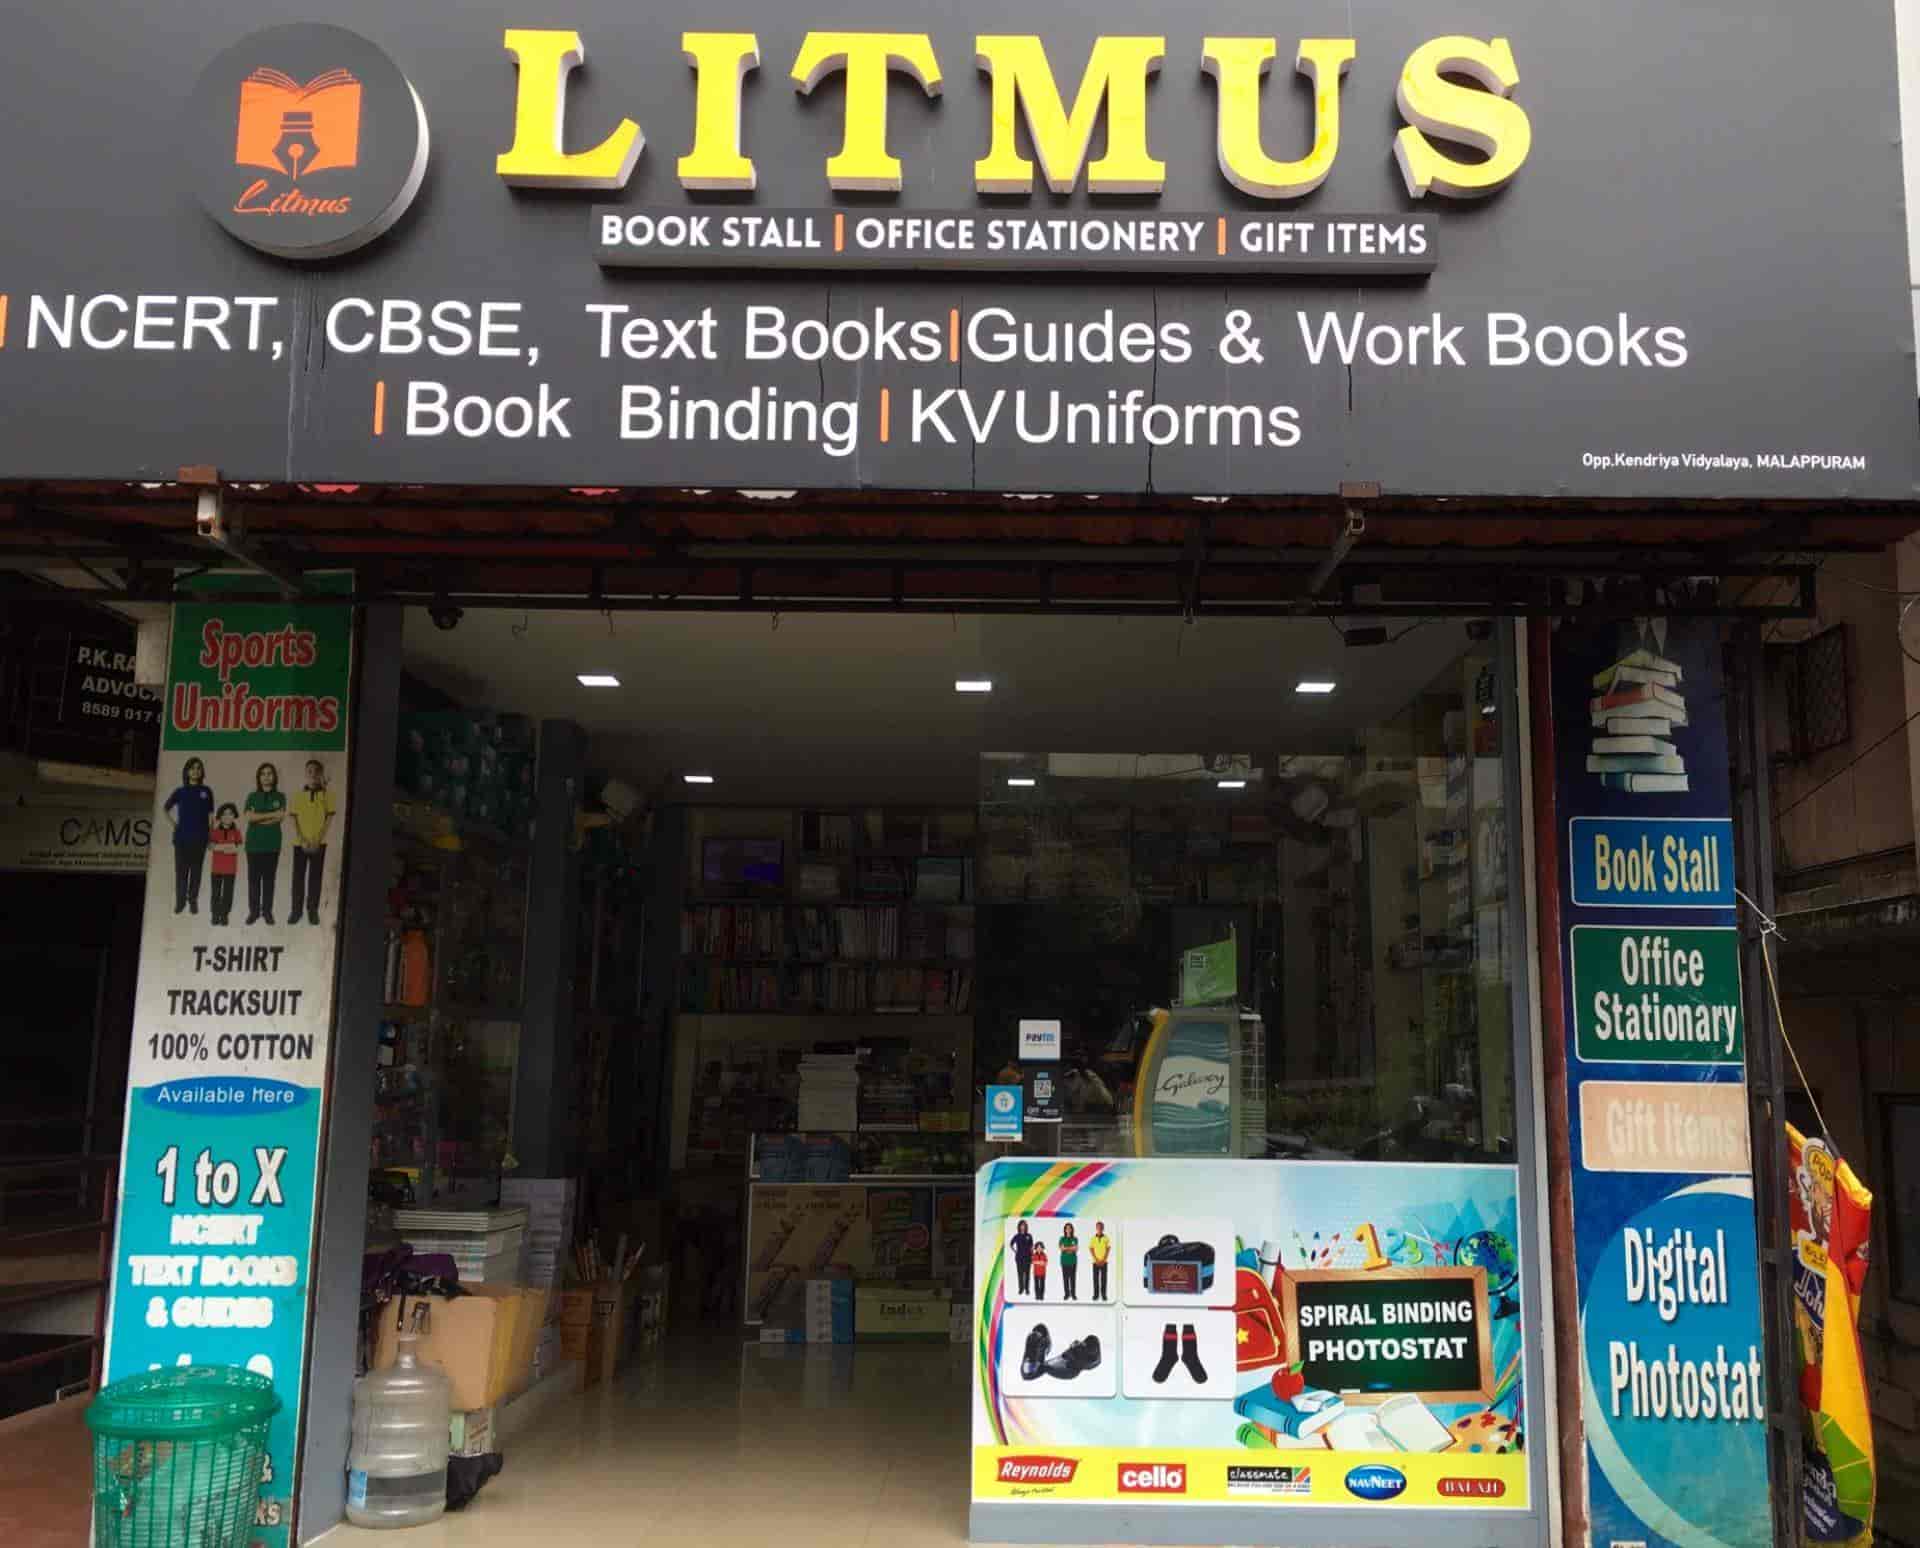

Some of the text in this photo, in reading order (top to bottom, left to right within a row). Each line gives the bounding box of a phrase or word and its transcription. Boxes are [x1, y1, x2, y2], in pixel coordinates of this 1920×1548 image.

[497, 28, 1531, 199] LITMUS
[234, 180, 351, 217] Litmus
[601, 215, 1427, 254] BOOK STALL OFFICE STATIONERY GIFT ITEMS
[26, 296, 285, 360] NCERT,
[325, 298, 540, 365] CBSE,
[586, 303, 717, 360] Text
[745, 305, 942, 362] Books
[1218, 309, 1264, 365] &
[1297, 311, 1465, 366] Work
[1488, 312, 1688, 367] Books
[406, 381, 572, 438] Book
[619, 385, 859, 457] Binding
[1757, 454, 1865, 470] MALAPPURAM
[199, 619, 316, 684] Sports
[172, 682, 339, 732] Uniforms
[1594, 833, 1721, 893] Book Stall
[192, 945, 284, 973] T-SHIRT
[1621, 936, 1705, 987] Office
[167, 989, 303, 1016] TRACKSUIT
[1593, 991, 1738, 1055] Stationary
[148, 1032, 314, 1061] 100% COTTON
[157, 1086, 295, 1104] Available Here
[1606, 1100, 1738, 1159] Gift Items
[156, 1145, 289, 1207] 1 to X
[1623, 1226, 1729, 1321] Digital
[1300, 1301, 1473, 1328] SPIRAL BINDING
[1308, 1337, 1468, 1362] PHOTOSTAT
[1608, 1340, 1765, 1421] Photostat
[1001, 1461, 1073, 1481] Reynolds
[1122, 1466, 1182, 1488] cello
